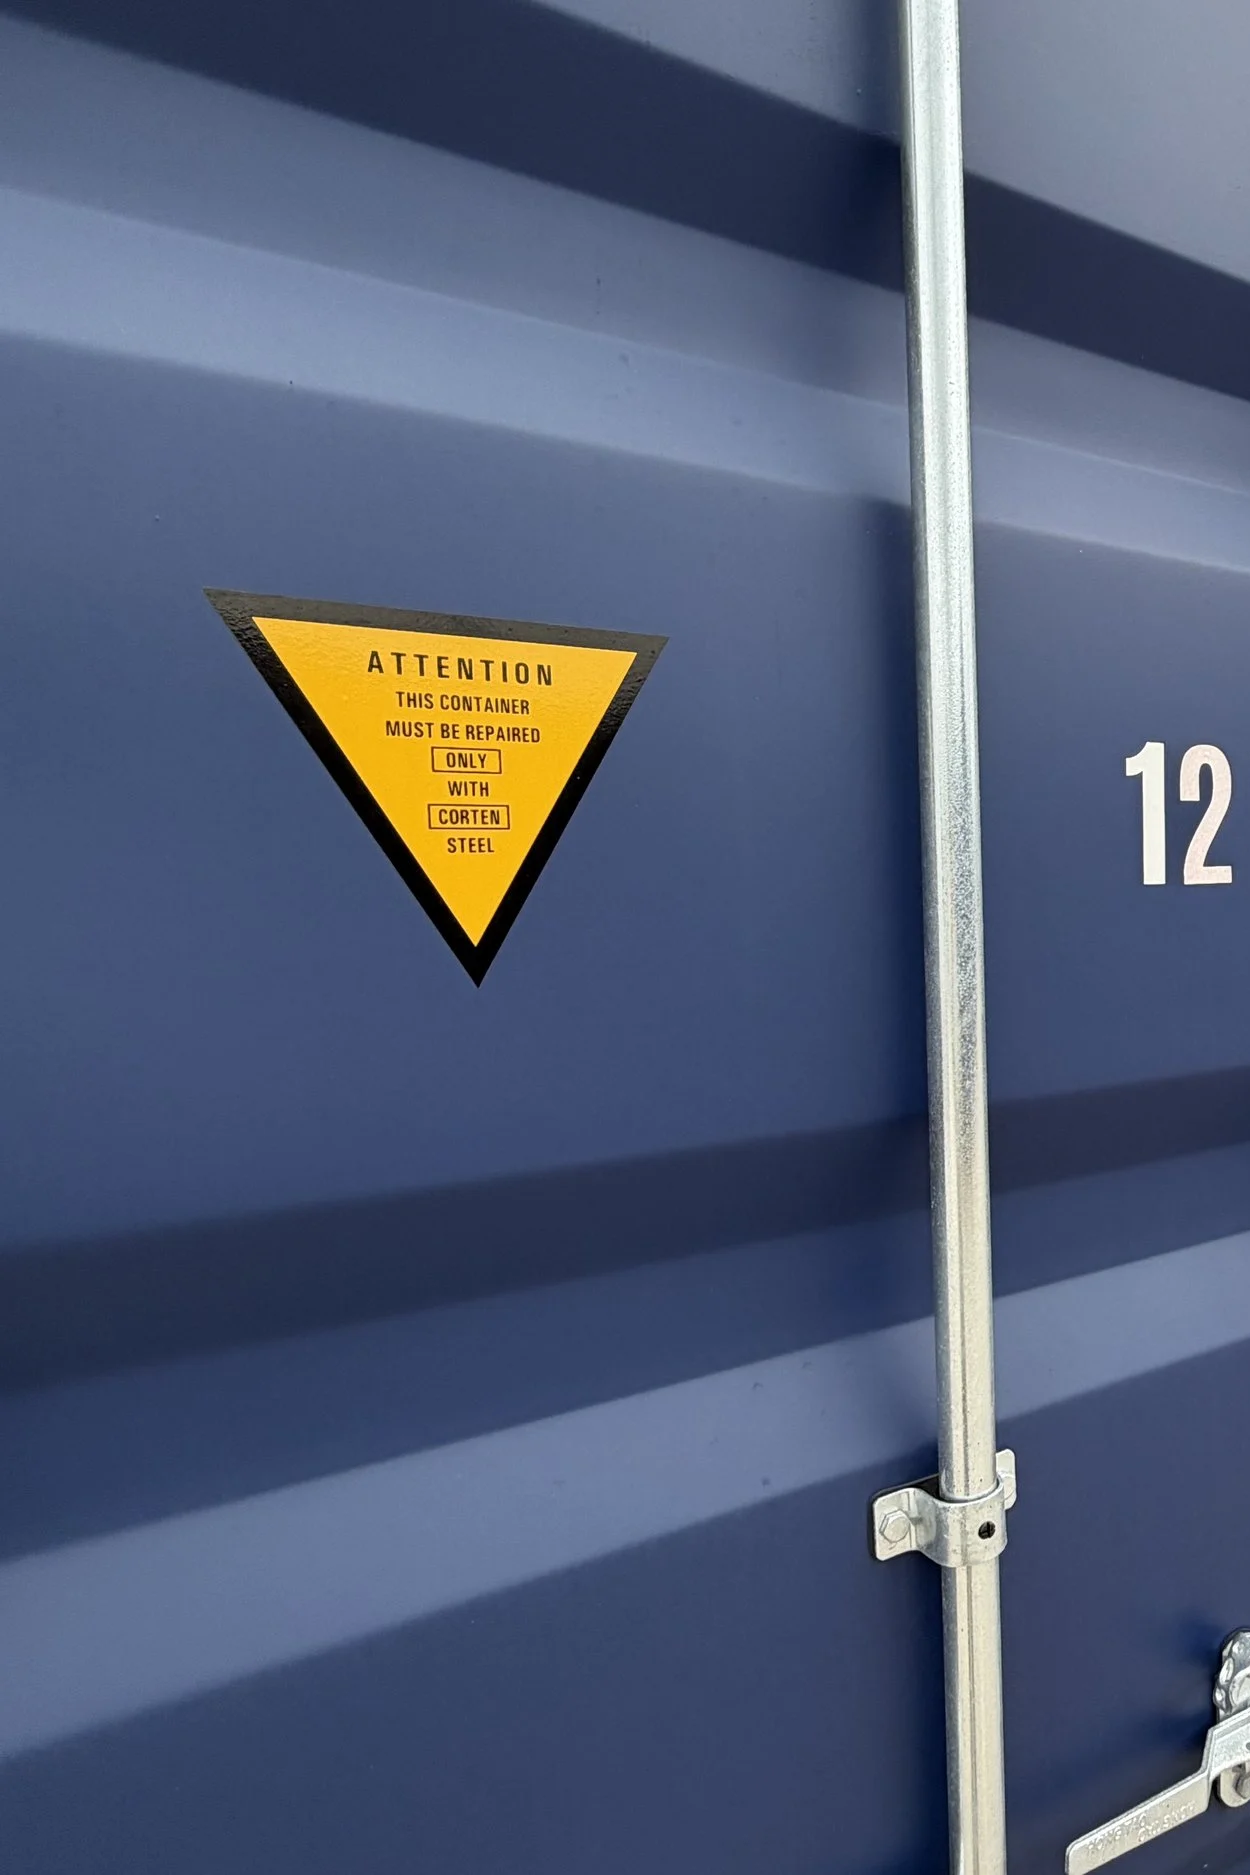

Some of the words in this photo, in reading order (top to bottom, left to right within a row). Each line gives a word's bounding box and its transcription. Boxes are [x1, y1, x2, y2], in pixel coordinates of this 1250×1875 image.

[367, 651, 552, 686] ATTENTION
[395, 691, 434, 710] THIS
[439, 694, 530, 715] CONTAINER
[385, 720, 435, 739] MUST
[440, 723, 460, 740] BE
[465, 725, 541, 743] REPAIRED
[445, 753, 488, 770] ONLY
[447, 780, 490, 797] WITH
[438, 809, 501, 826] CORTEN
[1125, 741, 1233, 886] 12
[447, 837, 495, 854] STEEL
